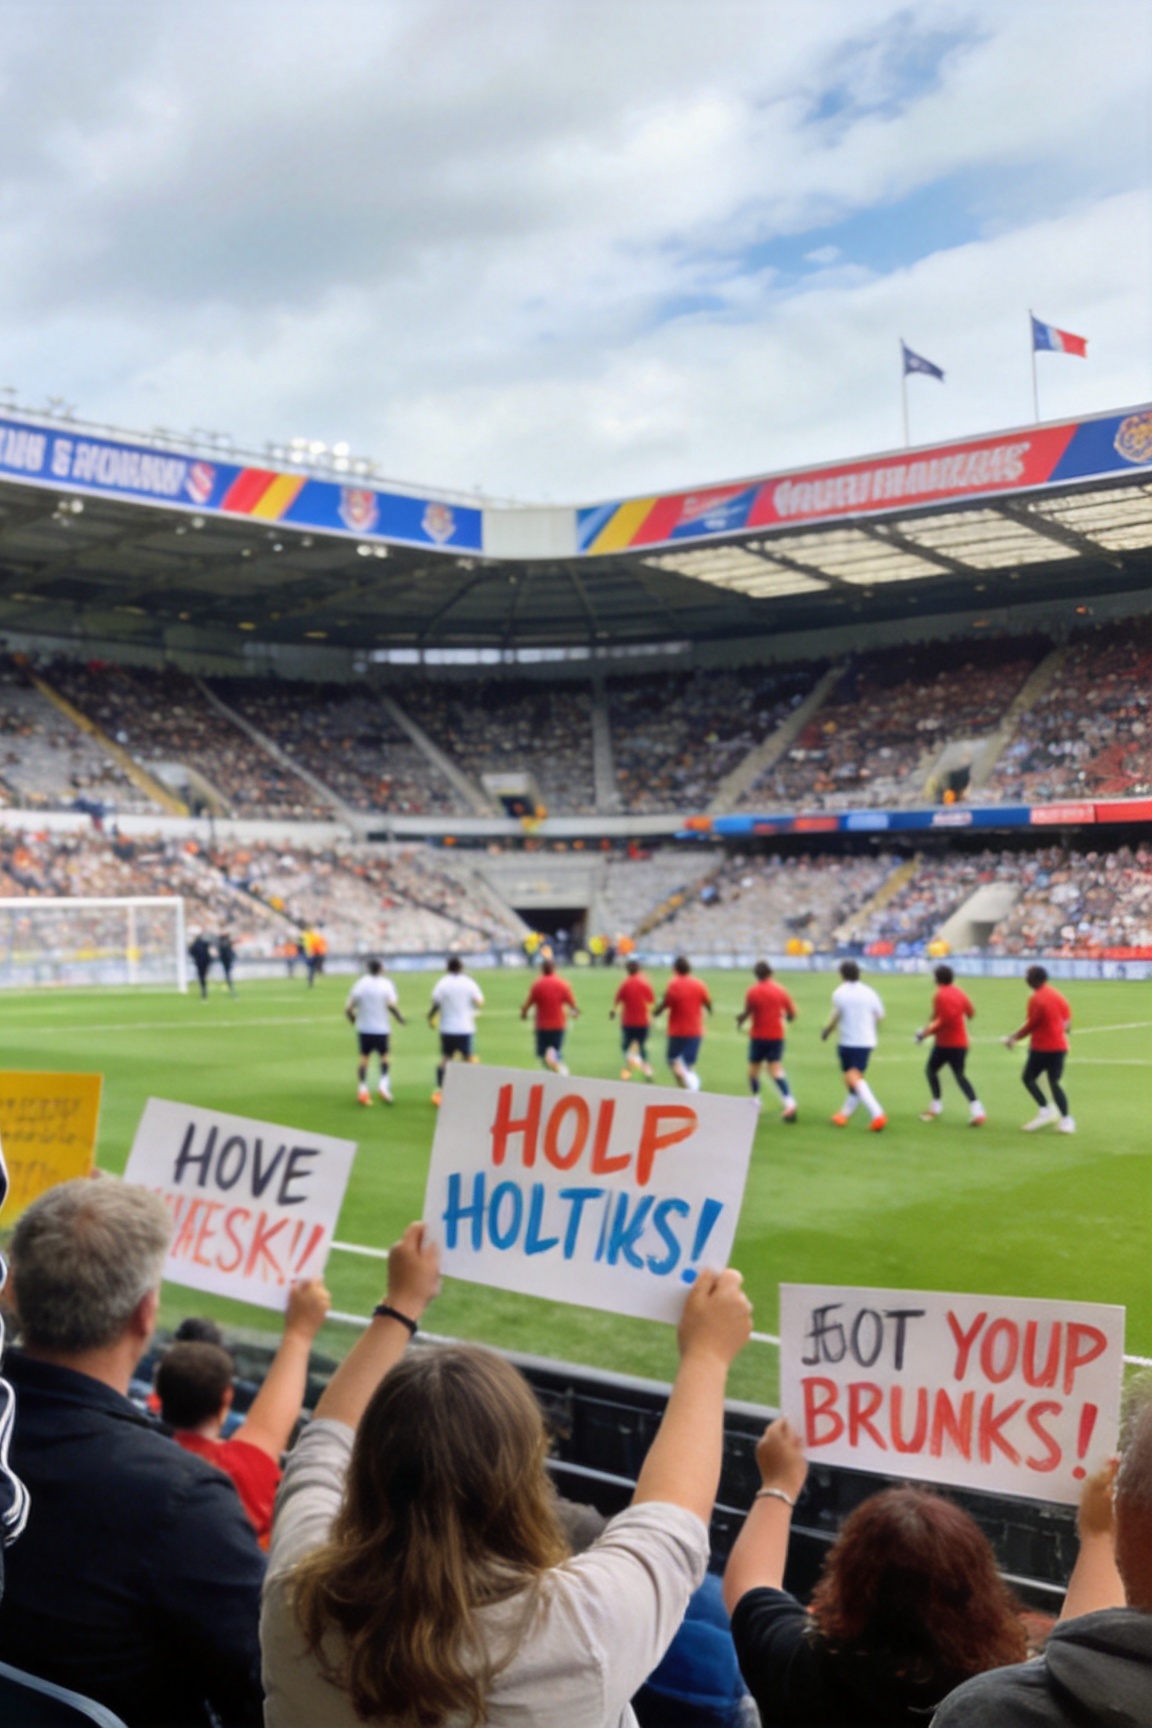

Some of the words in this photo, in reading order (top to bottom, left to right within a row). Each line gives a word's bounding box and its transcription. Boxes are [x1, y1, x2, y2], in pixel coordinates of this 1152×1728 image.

[173, 1121, 322, 1206] HOVE
[490, 1084, 698, 1187] HOLP
[946, 1309, 1108, 1396] YOUP
[801, 1376, 1098, 1480] BRUNKS!
